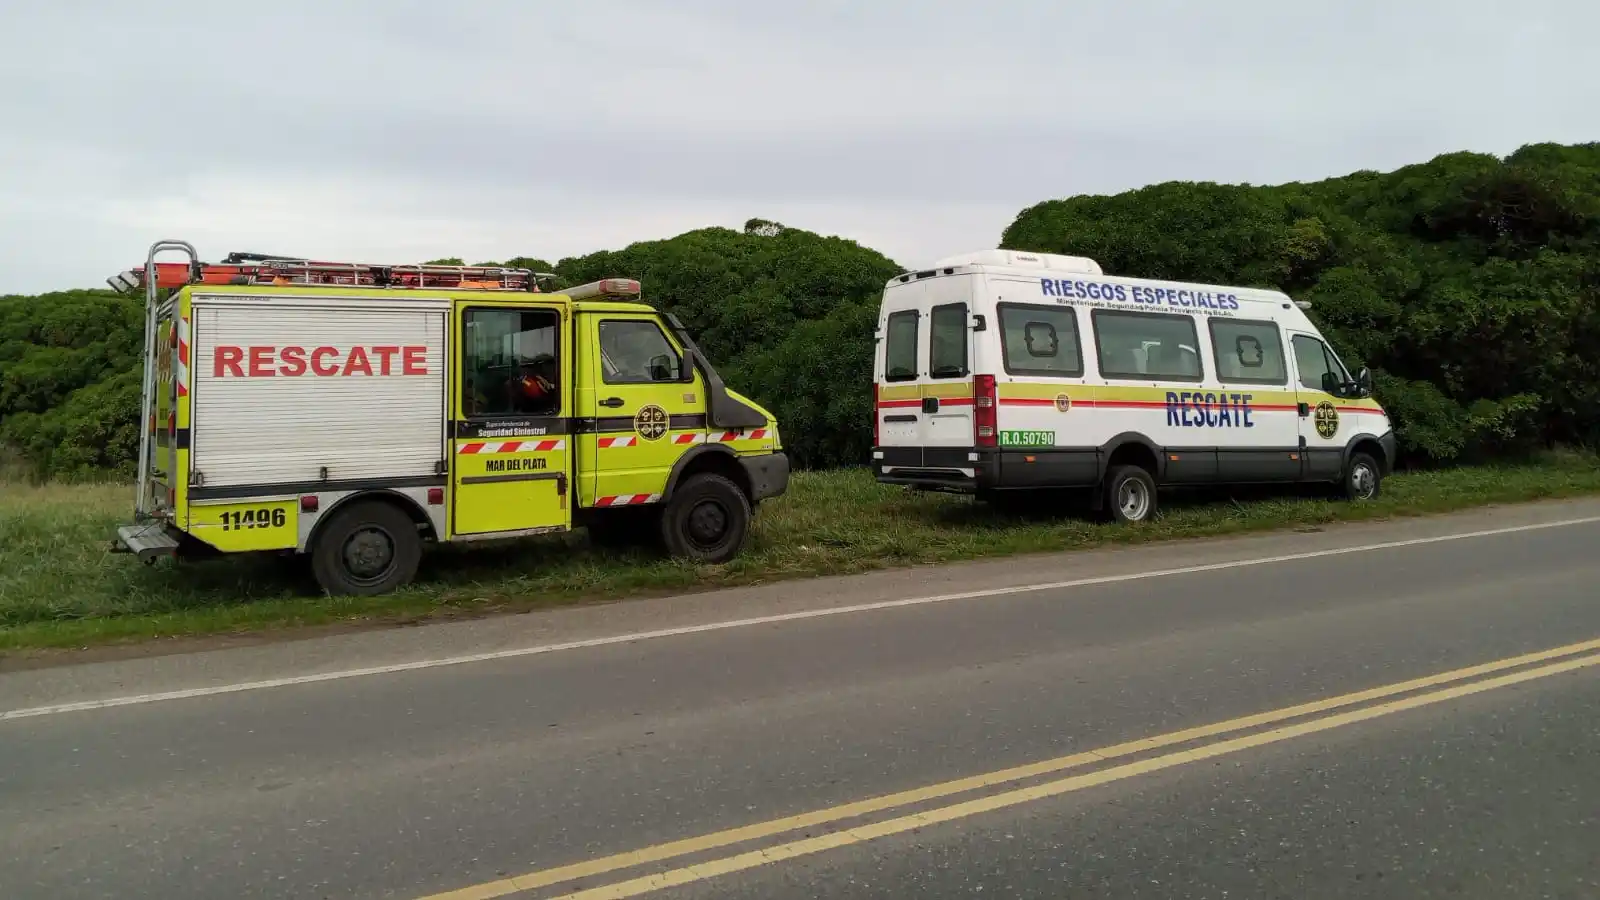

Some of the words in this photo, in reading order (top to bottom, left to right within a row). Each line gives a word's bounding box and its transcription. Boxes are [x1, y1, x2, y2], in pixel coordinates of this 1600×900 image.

[1041, 278, 1126, 301] RIESGOS
[1132, 286, 1239, 310] ESPECIALES
[213, 346, 428, 377] RESCATE
[1166, 391, 1254, 428] RESCATE
[478, 428, 513, 437] Seguridad
[1002, 431, 1054, 445] R.O.50790
[486, 459, 505, 472] MAR
[507, 458, 521, 471] DEL
[523, 457, 547, 470] PLATA
[219, 508, 286, 531] 11496
